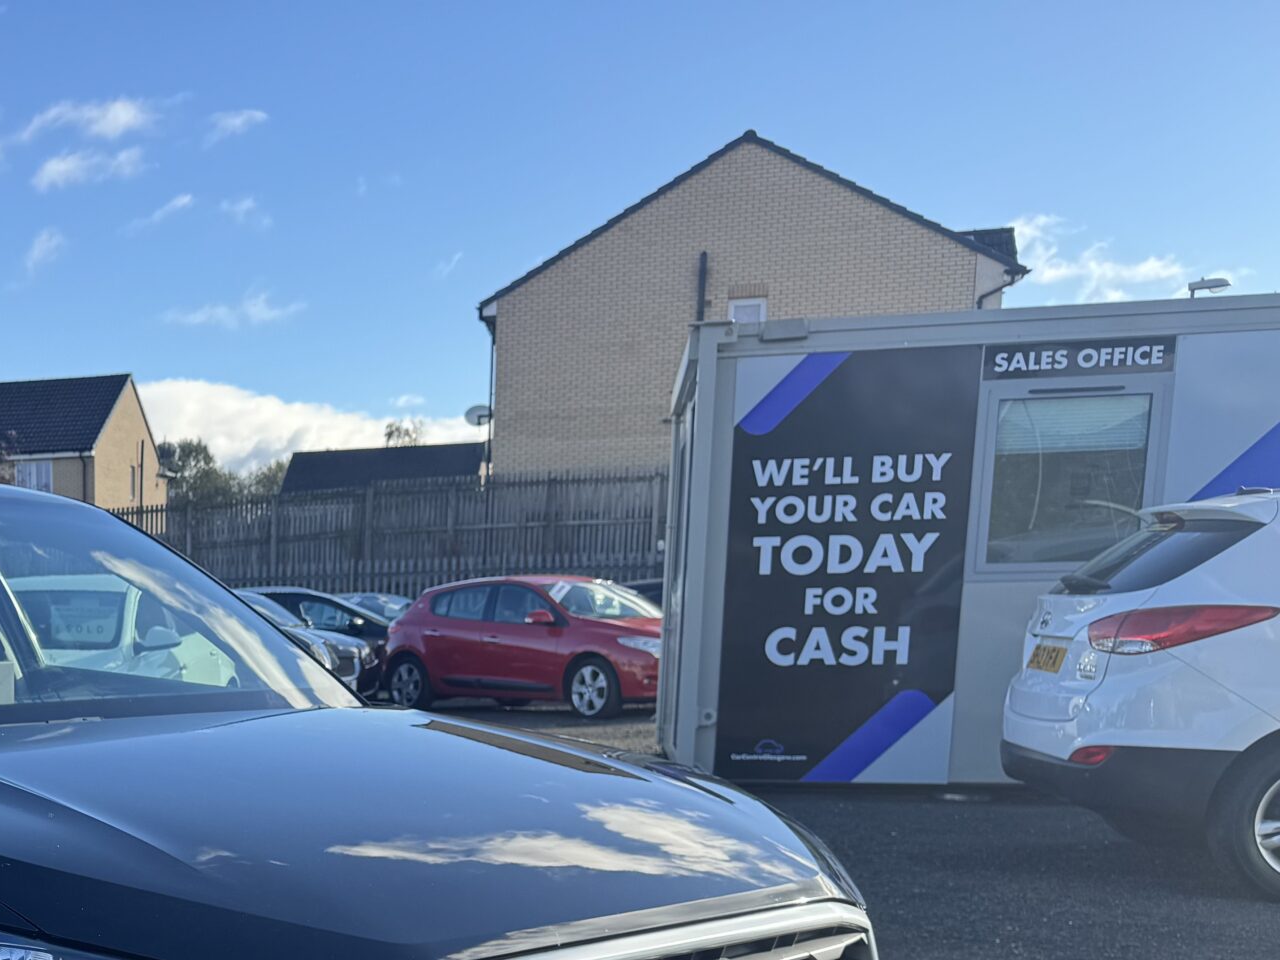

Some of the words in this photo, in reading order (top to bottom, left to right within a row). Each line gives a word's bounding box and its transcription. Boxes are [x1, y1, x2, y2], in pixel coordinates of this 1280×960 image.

[993, 350, 1068, 372] SALES
[1076, 345, 1165, 368] OFFICE
[752, 456, 860, 487] WE'LL
[871, 453, 953, 484] BUY
[750, 494, 858, 525] YOUR
[870, 491, 947, 522] CAR
[752, 532, 941, 577] TODAY
[804, 586, 878, 616] FOR
[764, 625, 911, 667] CASH
